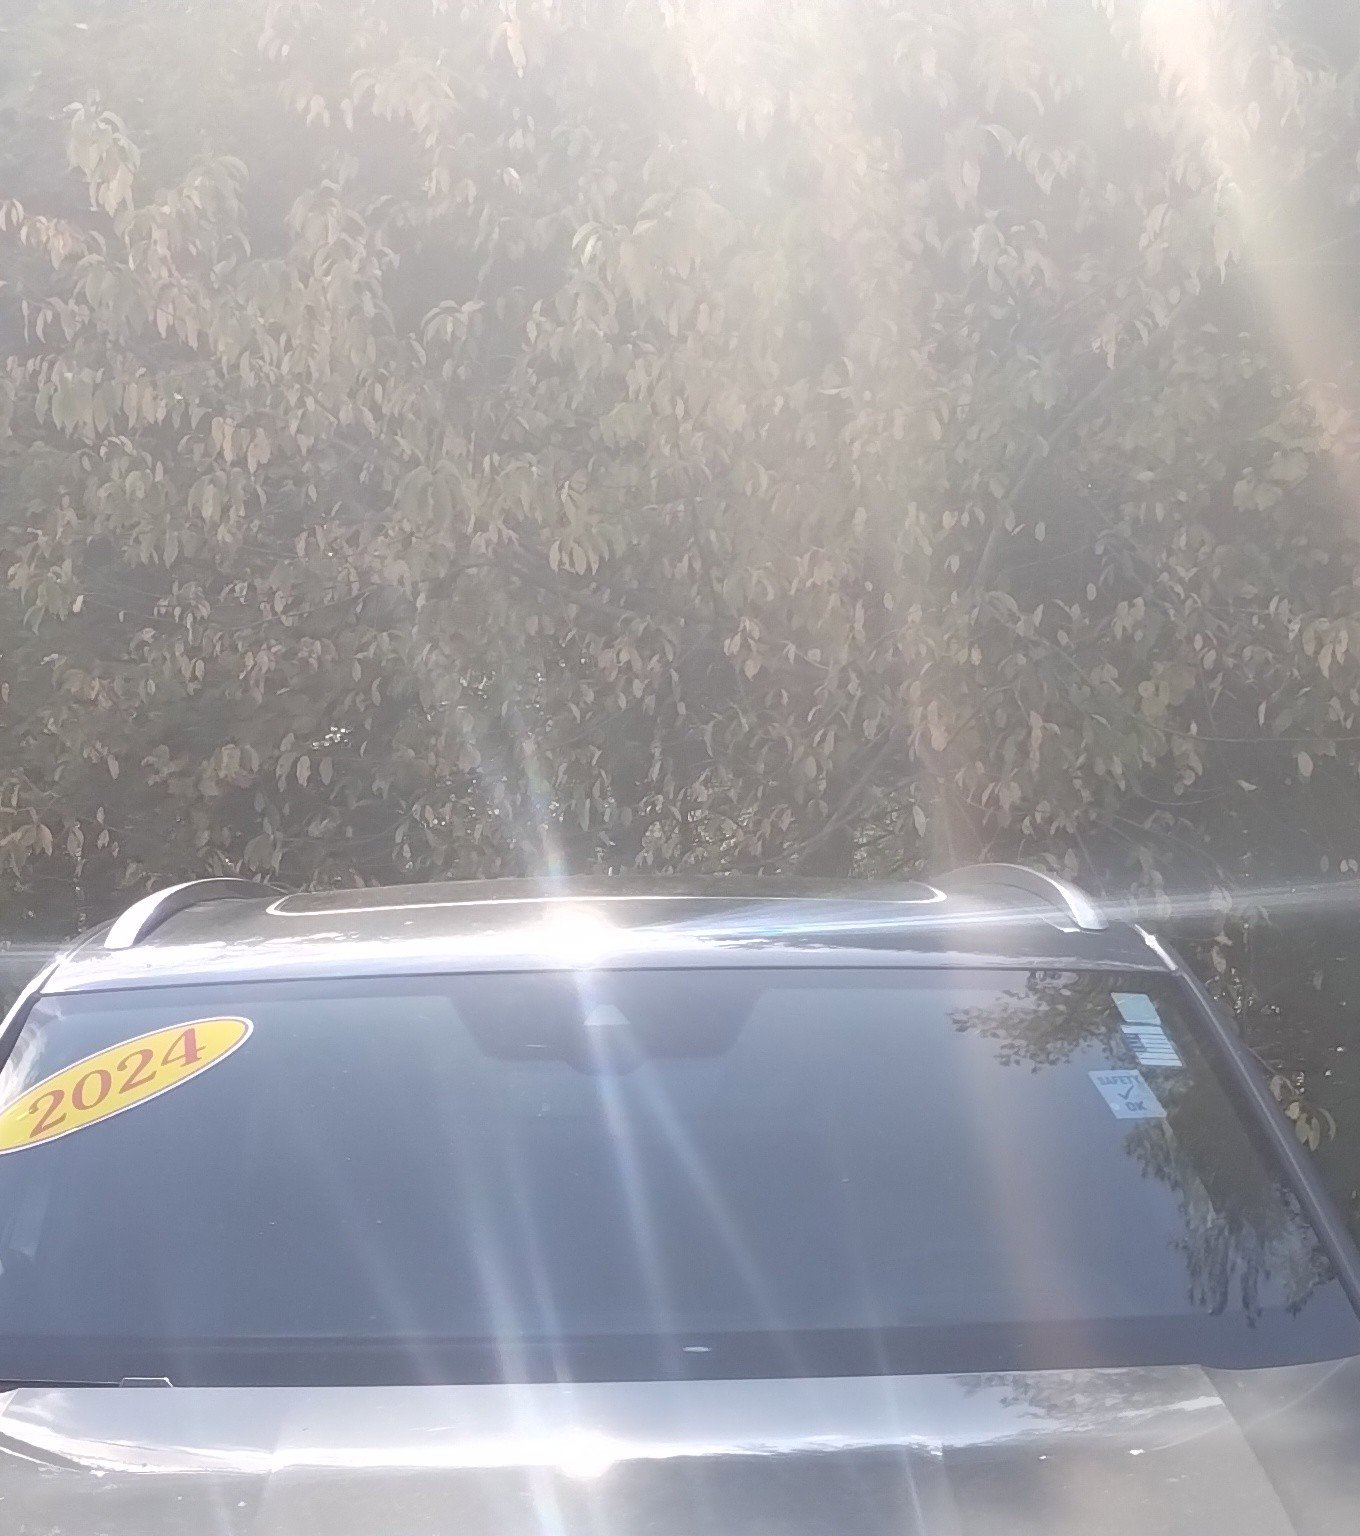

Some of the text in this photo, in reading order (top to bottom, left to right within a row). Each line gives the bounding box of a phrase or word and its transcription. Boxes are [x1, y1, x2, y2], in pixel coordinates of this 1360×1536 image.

[28, 1027, 206, 1139] 2024
[1097, 1075, 1141, 1086] SAFETY
[1125, 1101, 1147, 1112] OK
